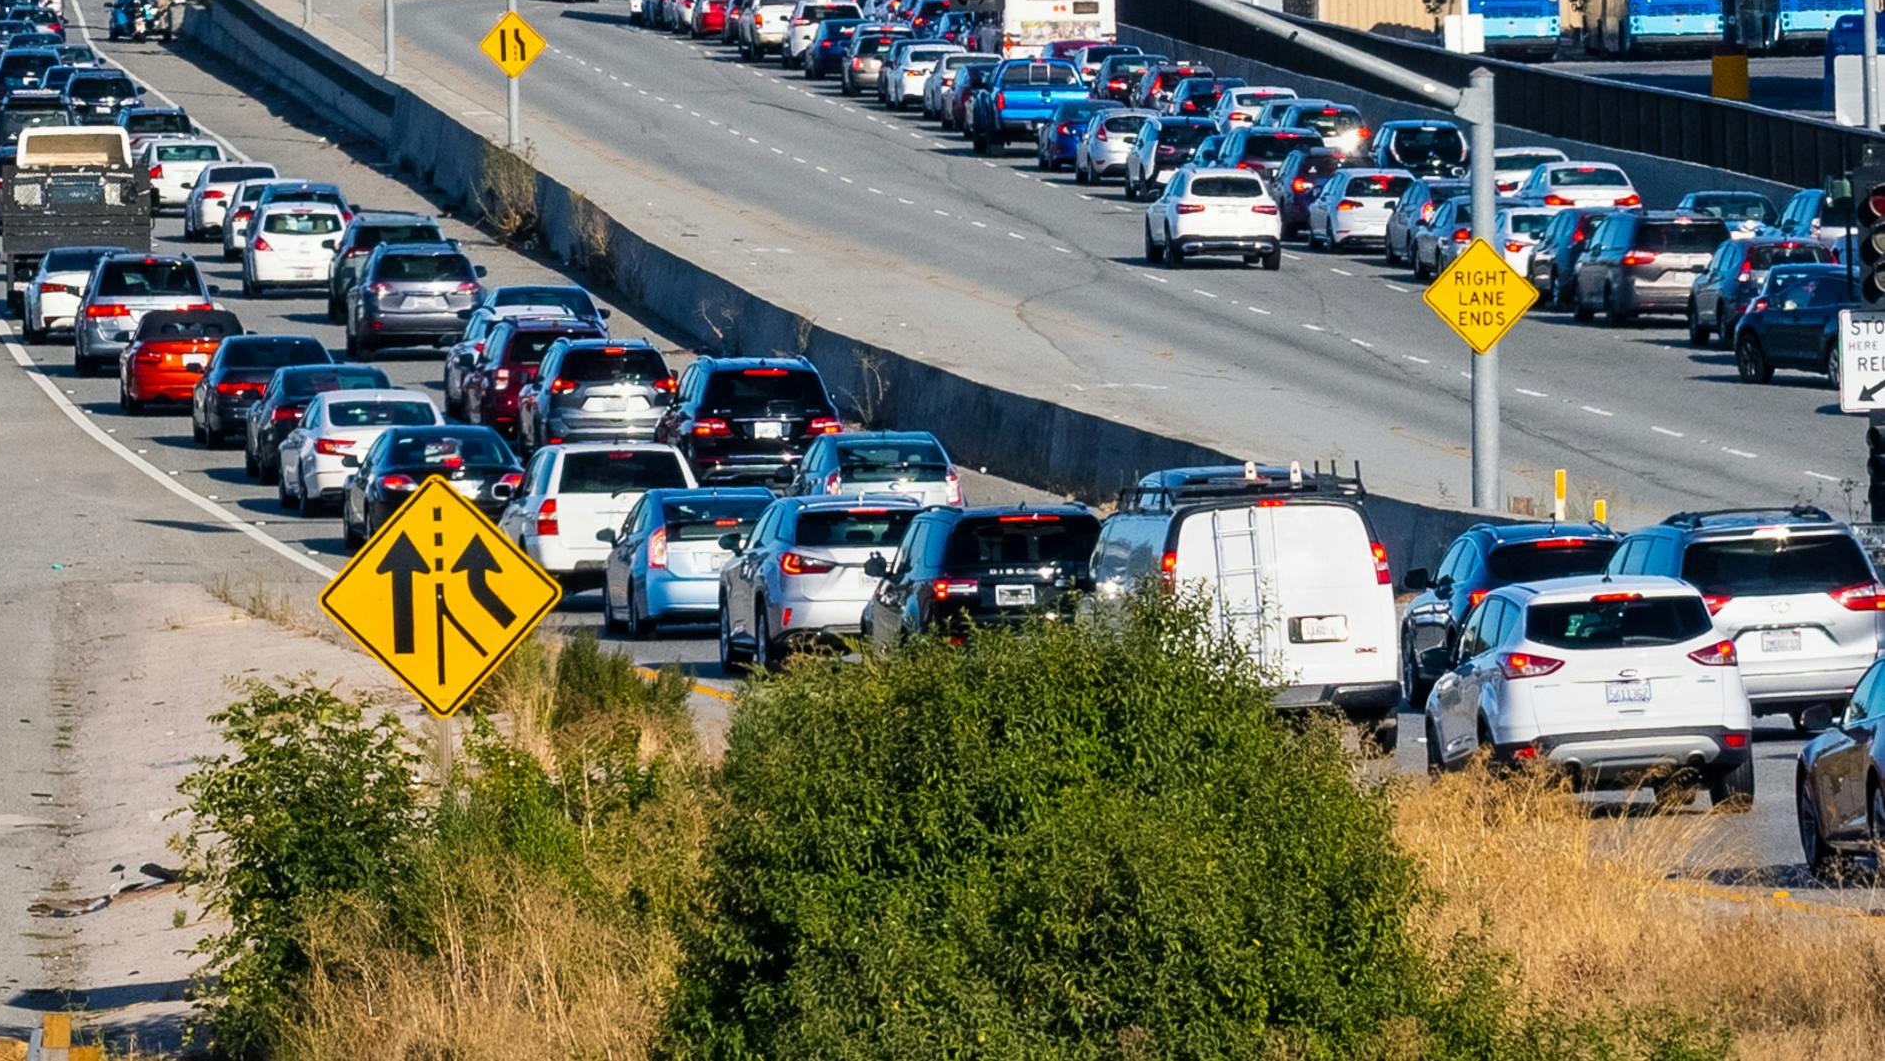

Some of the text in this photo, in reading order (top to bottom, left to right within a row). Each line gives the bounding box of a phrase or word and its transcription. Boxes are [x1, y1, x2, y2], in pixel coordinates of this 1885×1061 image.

[1454, 271, 1507, 286] RIGHT
[1459, 291, 1505, 306] LANE
[1459, 311, 1505, 326] ENDS
[1848, 341, 1878, 351] HERE
